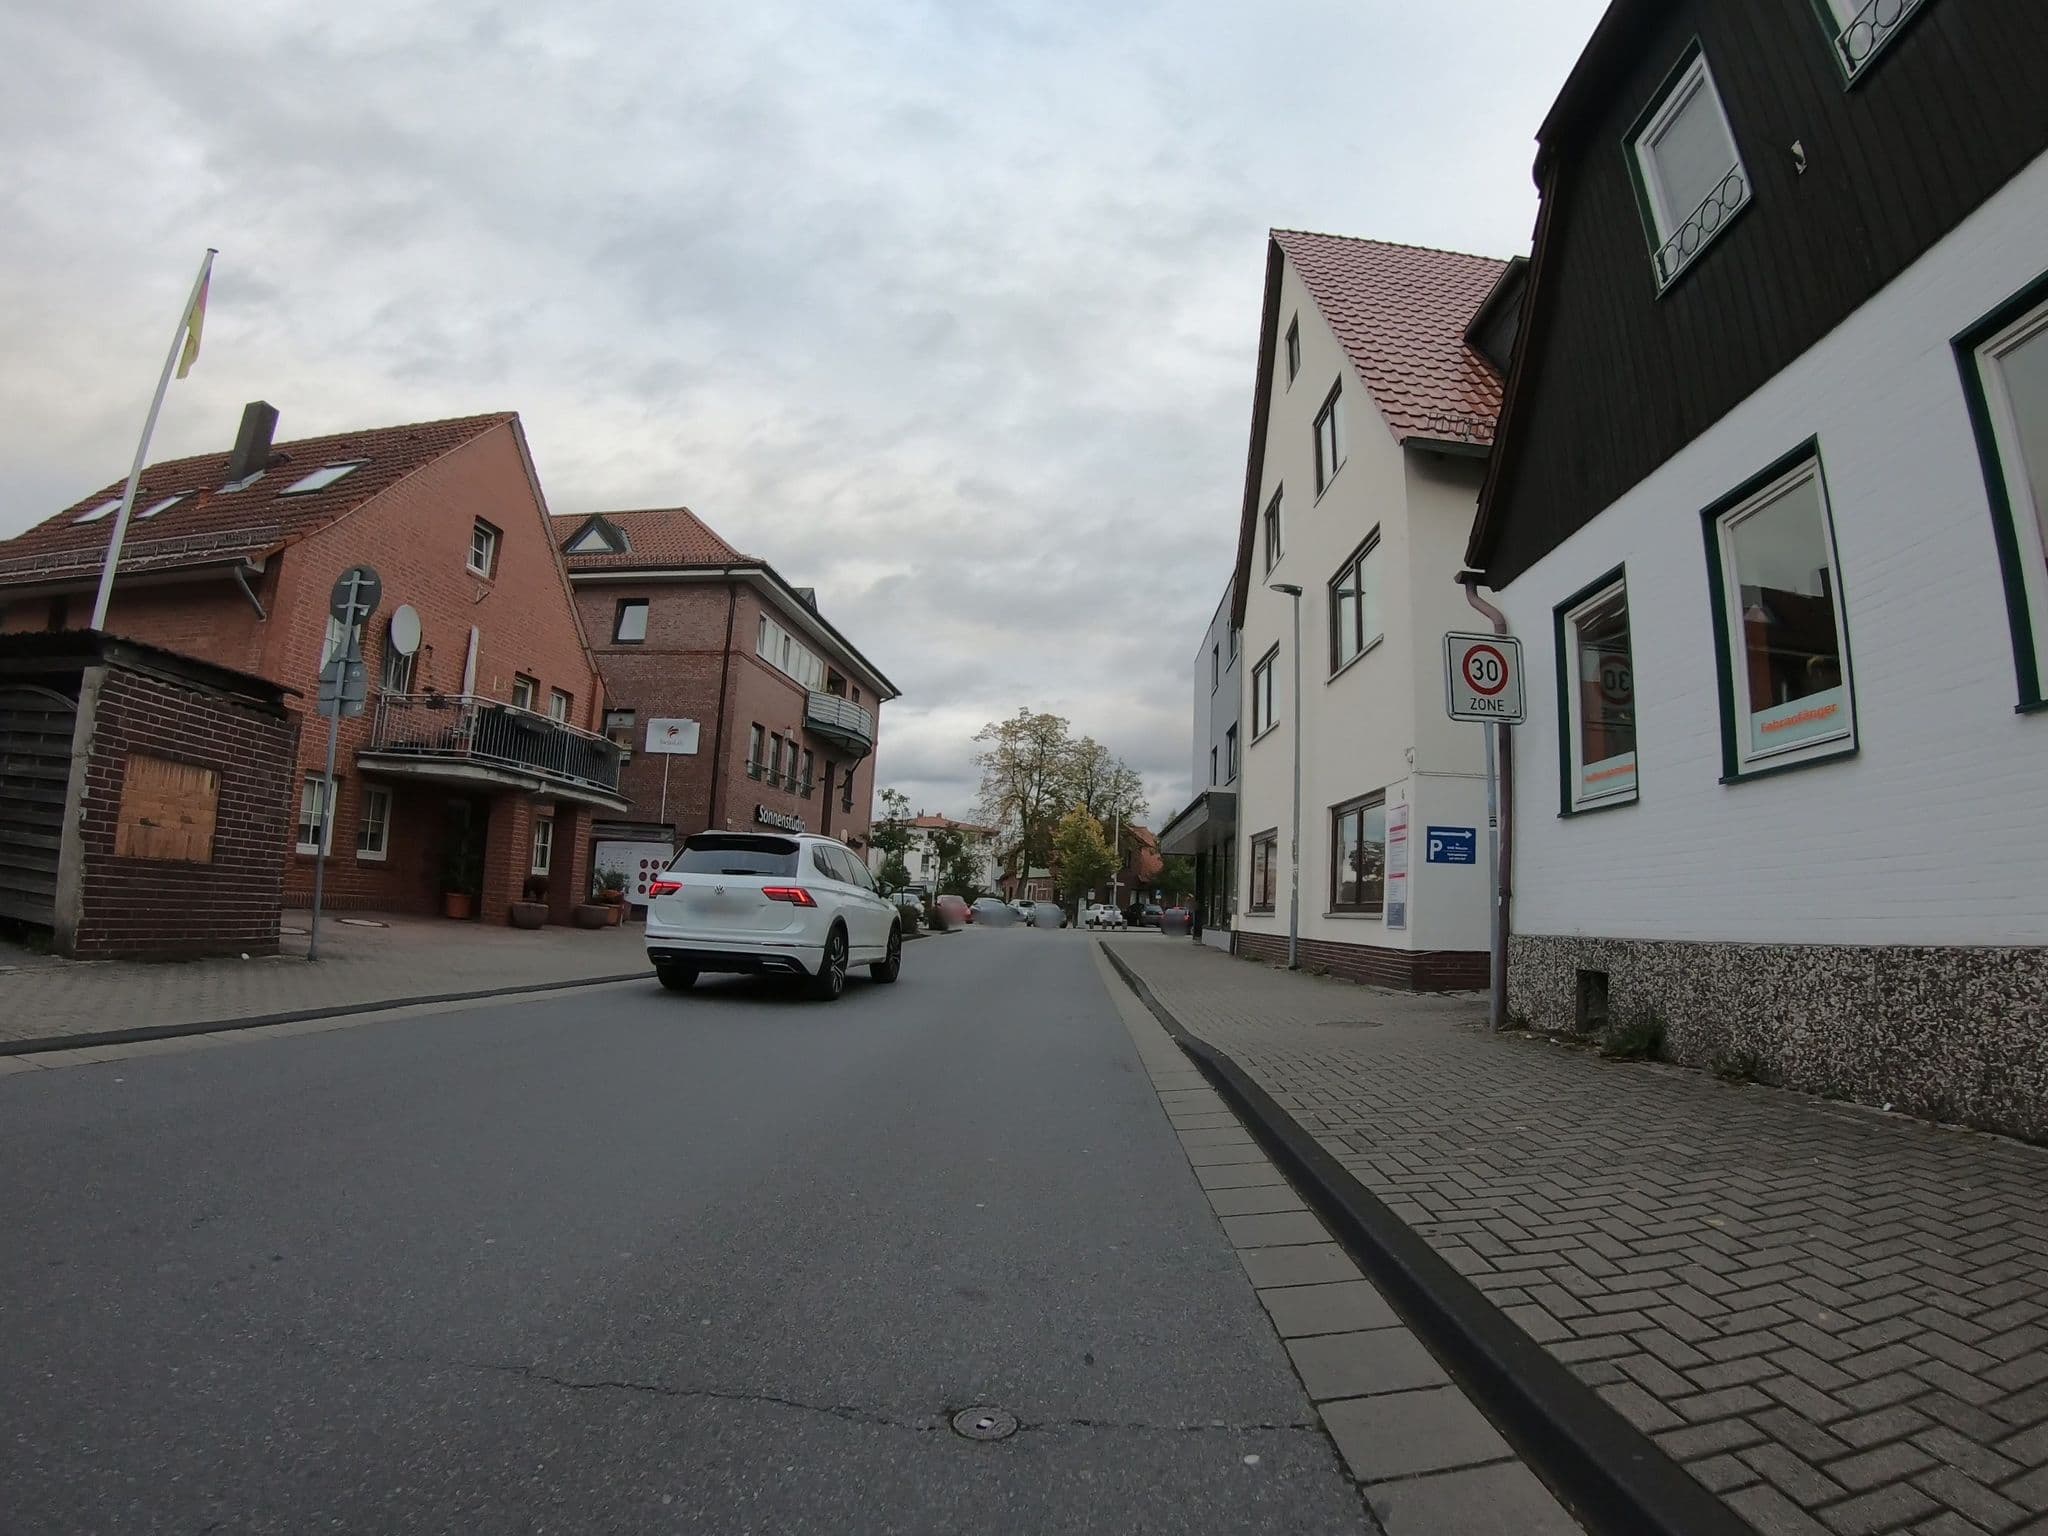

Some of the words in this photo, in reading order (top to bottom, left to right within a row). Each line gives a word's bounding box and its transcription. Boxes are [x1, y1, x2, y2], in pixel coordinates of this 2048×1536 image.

[1472, 658, 1499, 682] 30
[1470, 697, 1504, 712] ZONE
[758, 804, 806, 833] Sonnenstudio
[1430, 839, 1443, 860] P
